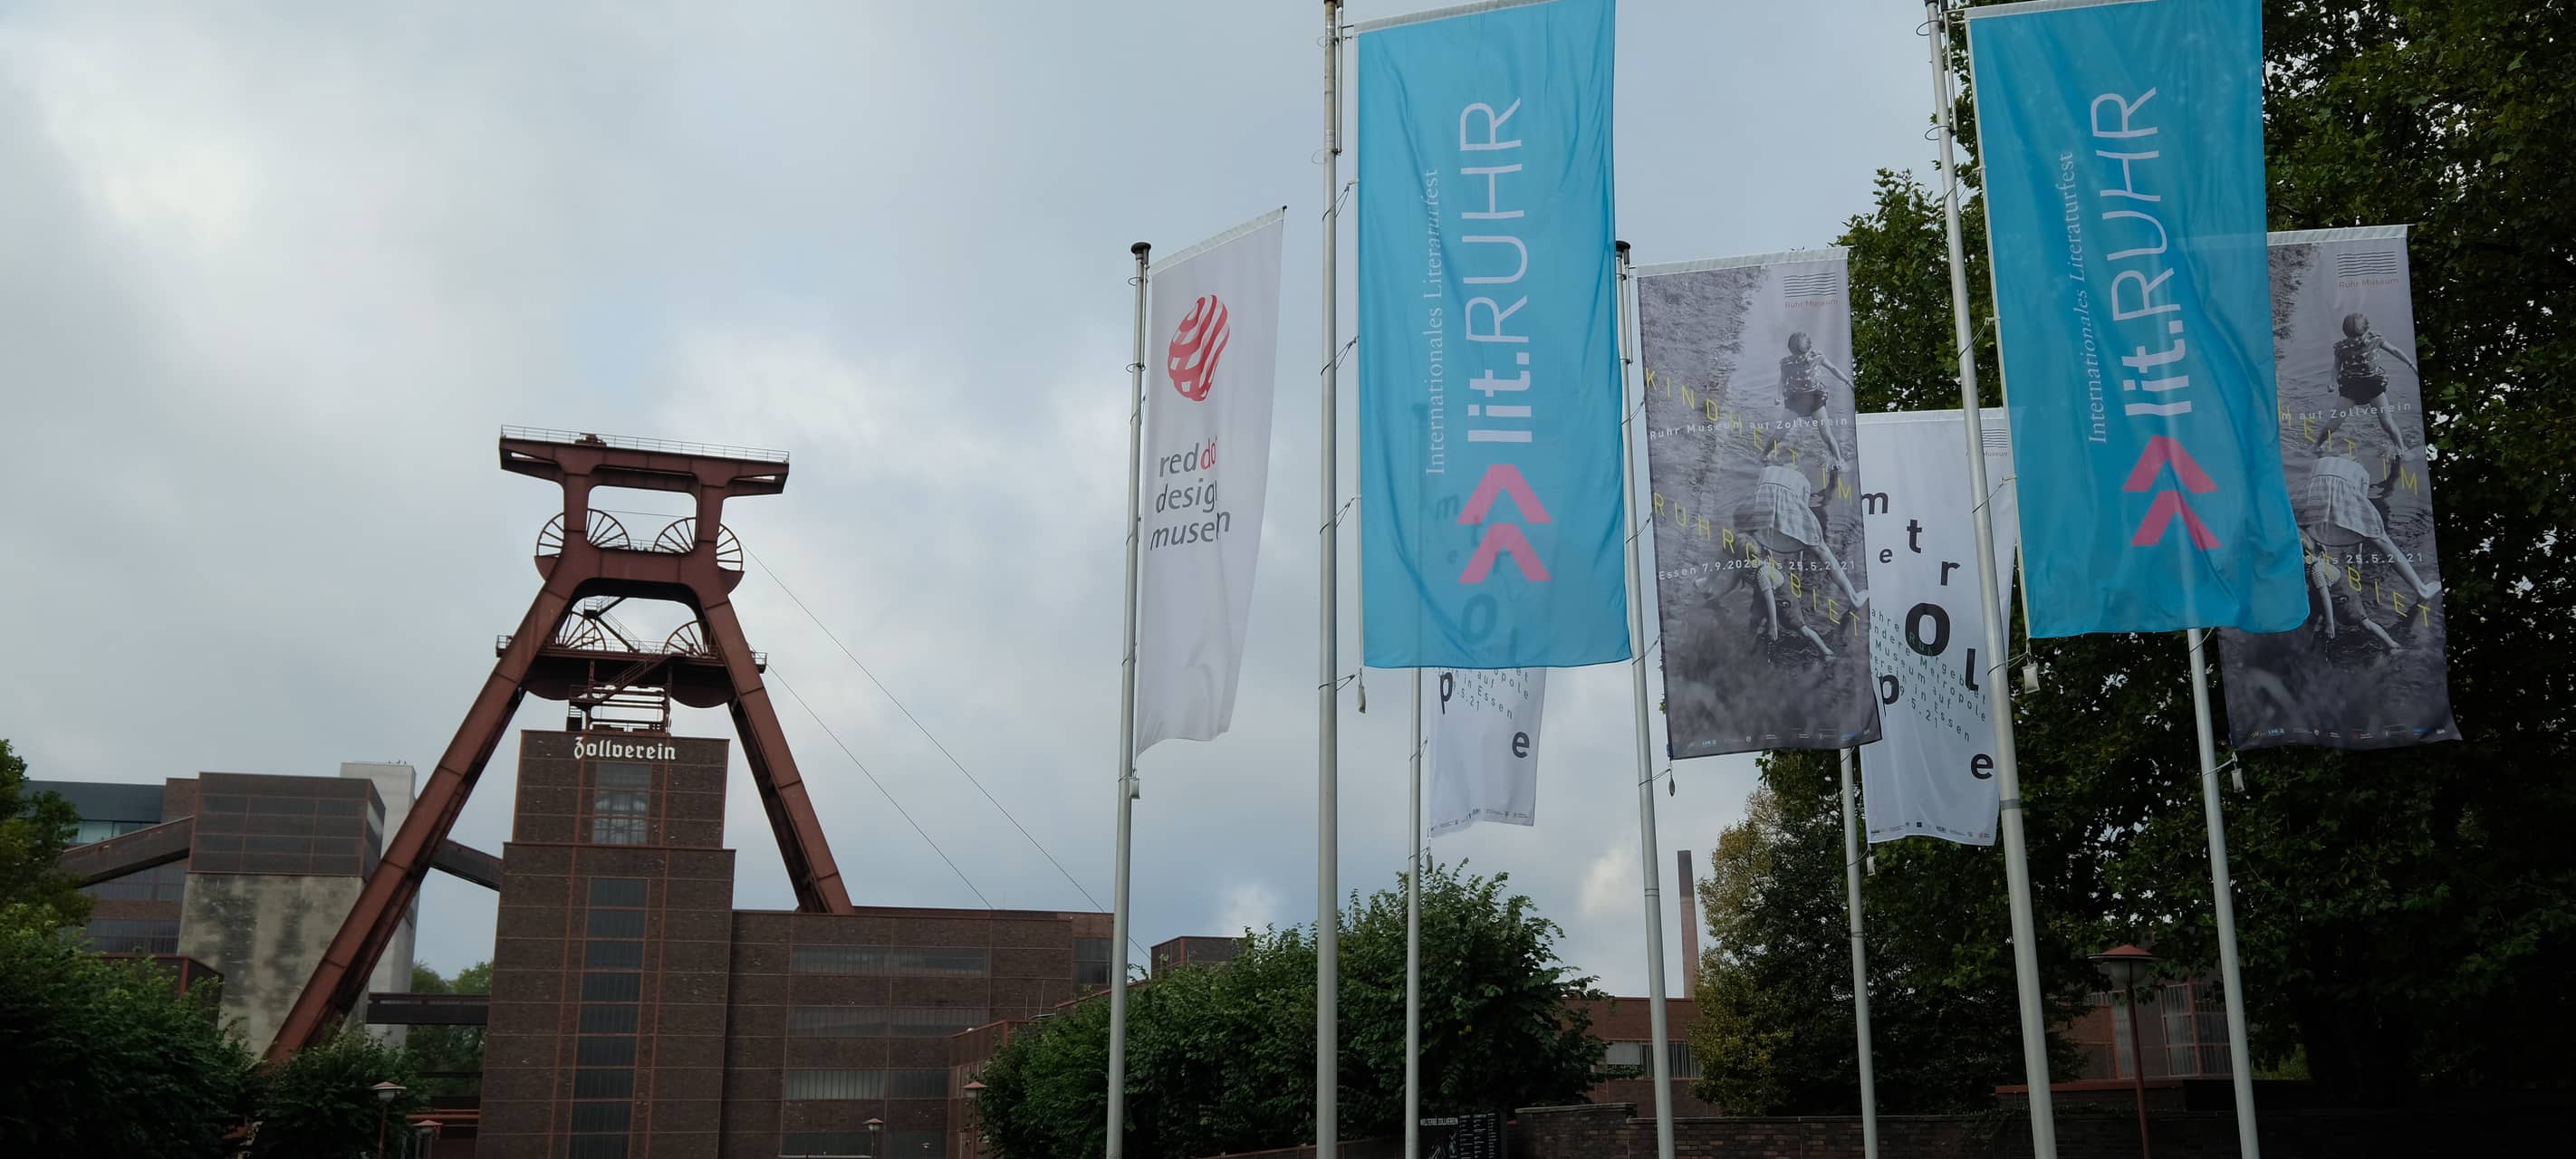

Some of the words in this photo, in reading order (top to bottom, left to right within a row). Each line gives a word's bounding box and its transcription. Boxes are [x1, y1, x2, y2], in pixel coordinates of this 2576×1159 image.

[1420, 168, 1442, 299] Literaturfest
[2055, 152, 2086, 283] Literaturfest
[1459, 97, 1533, 443] lit.RUHR
[2091, 87, 2193, 417] lit.RUHR
[2072, 290, 2107, 443] Internationales
[1423, 307, 1445, 474] Internationales
[2331, 402, 2411, 420] Zollverein
[1649, 427, 1681, 442] Ruhr
[1687, 419, 1743, 435] Museum
[1776, 417, 1849, 430] Zollverein
[1155, 477, 1217, 513] desig
[1658, 567, 1697, 580] Essen
[1789, 560, 1856, 572] 25.5.221
[2345, 551, 2424, 565] 25.5.221
[1870, 608, 1900, 633] ahre
[1477, 685, 1513, 720] Essen
[1934, 701, 1970, 742] Essen
[573, 736, 676, 760] Zollverein
